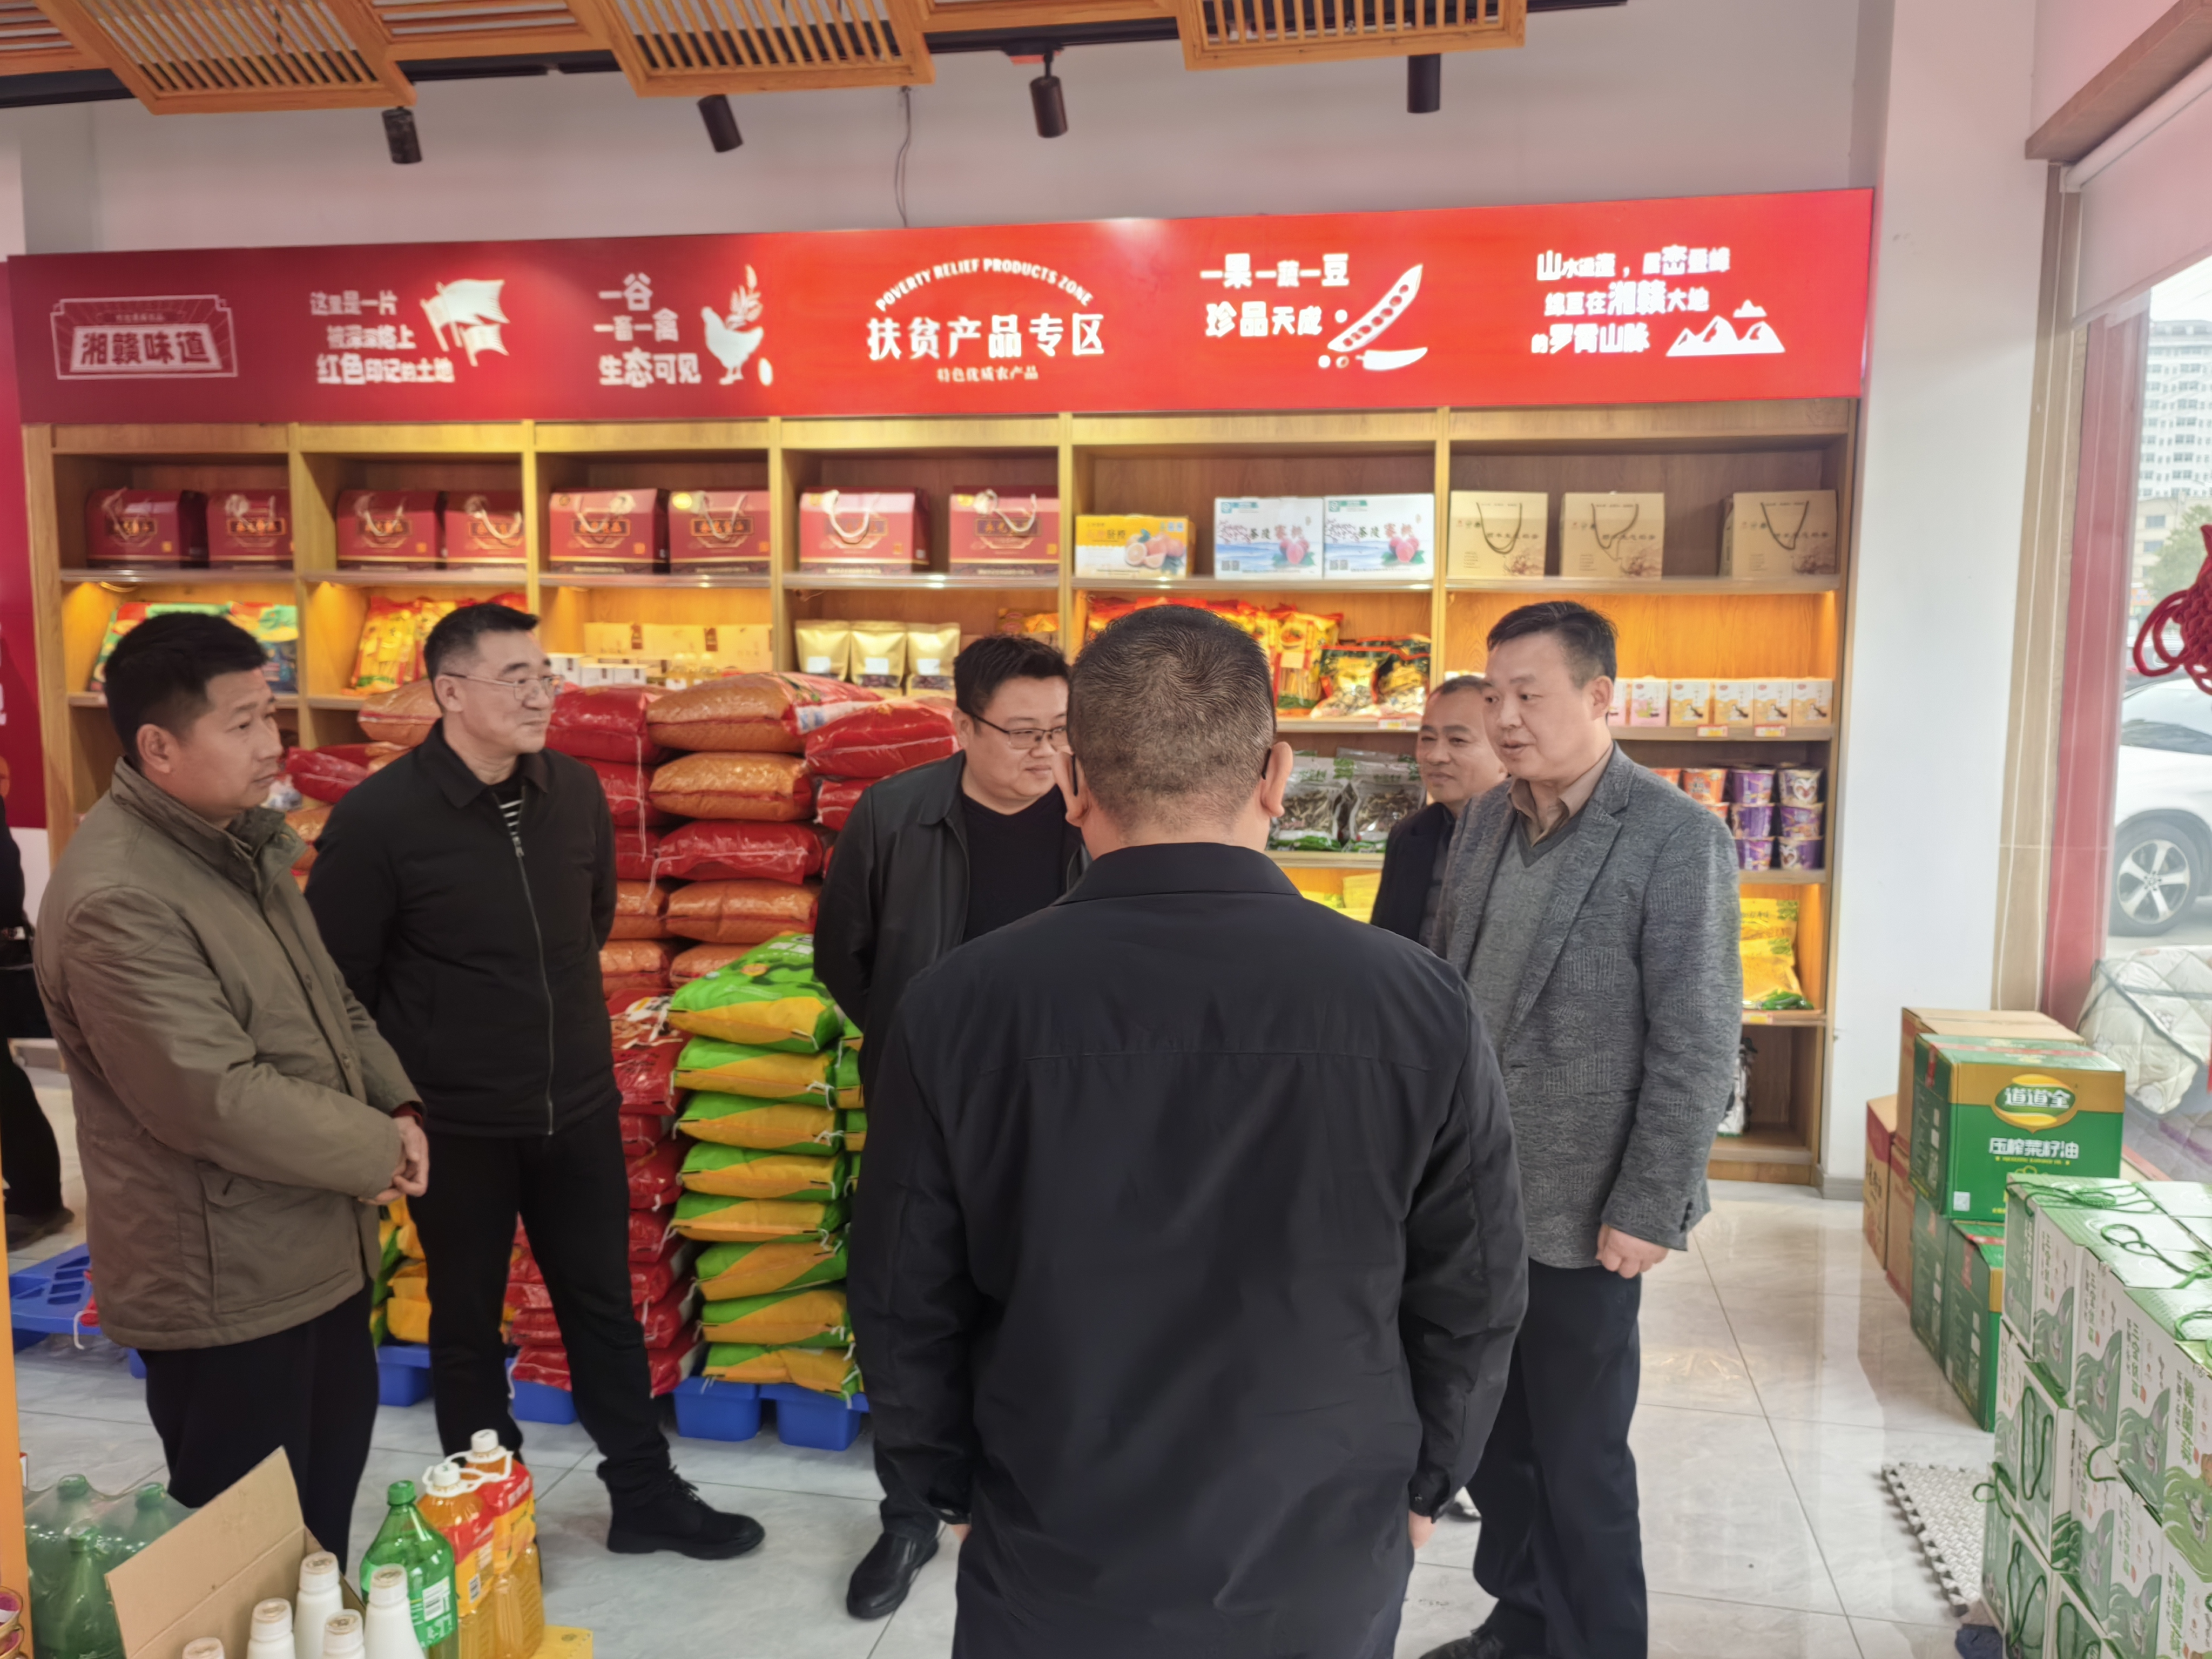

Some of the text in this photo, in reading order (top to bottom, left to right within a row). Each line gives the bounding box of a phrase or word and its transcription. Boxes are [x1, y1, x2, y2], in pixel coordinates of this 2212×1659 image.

[598, 272, 653, 311] 一谷
[875, 258, 1093, 312] POVERTY RELIEF PRODUCTS ZONE
[867, 313, 1104, 361] 扶贫产品专区
[1205, 301, 1323, 338] 珍品天成
[80, 331, 211, 365] 湘赣味道
[316, 352, 455, 385] 红色印记的土地
[599, 346, 702, 388] 生态可见
[2005, 1087, 2071, 1108] 道道全
[1989, 1137, 2079, 1159] 压榨菜籽油
